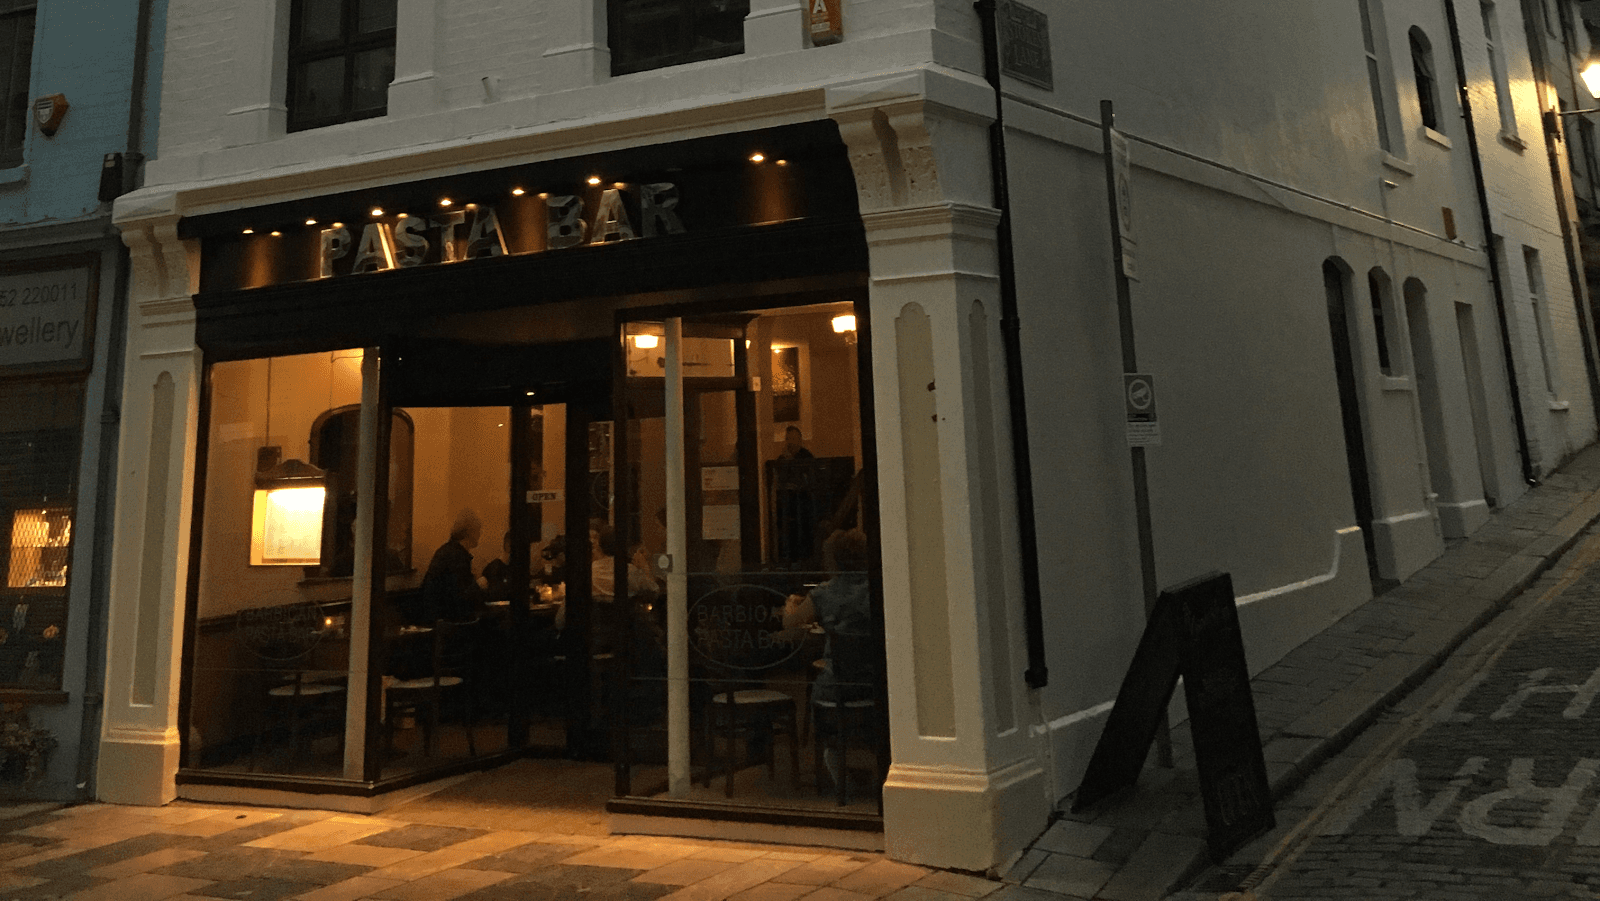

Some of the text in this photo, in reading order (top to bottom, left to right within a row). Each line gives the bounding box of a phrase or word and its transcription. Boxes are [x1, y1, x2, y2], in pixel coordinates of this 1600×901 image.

[319, 182, 688, 278] PASTA BAR
[22, 283, 77, 305] 220011
[532, 493, 556, 501] OPEN
[697, 605, 784, 623] BARBICA
